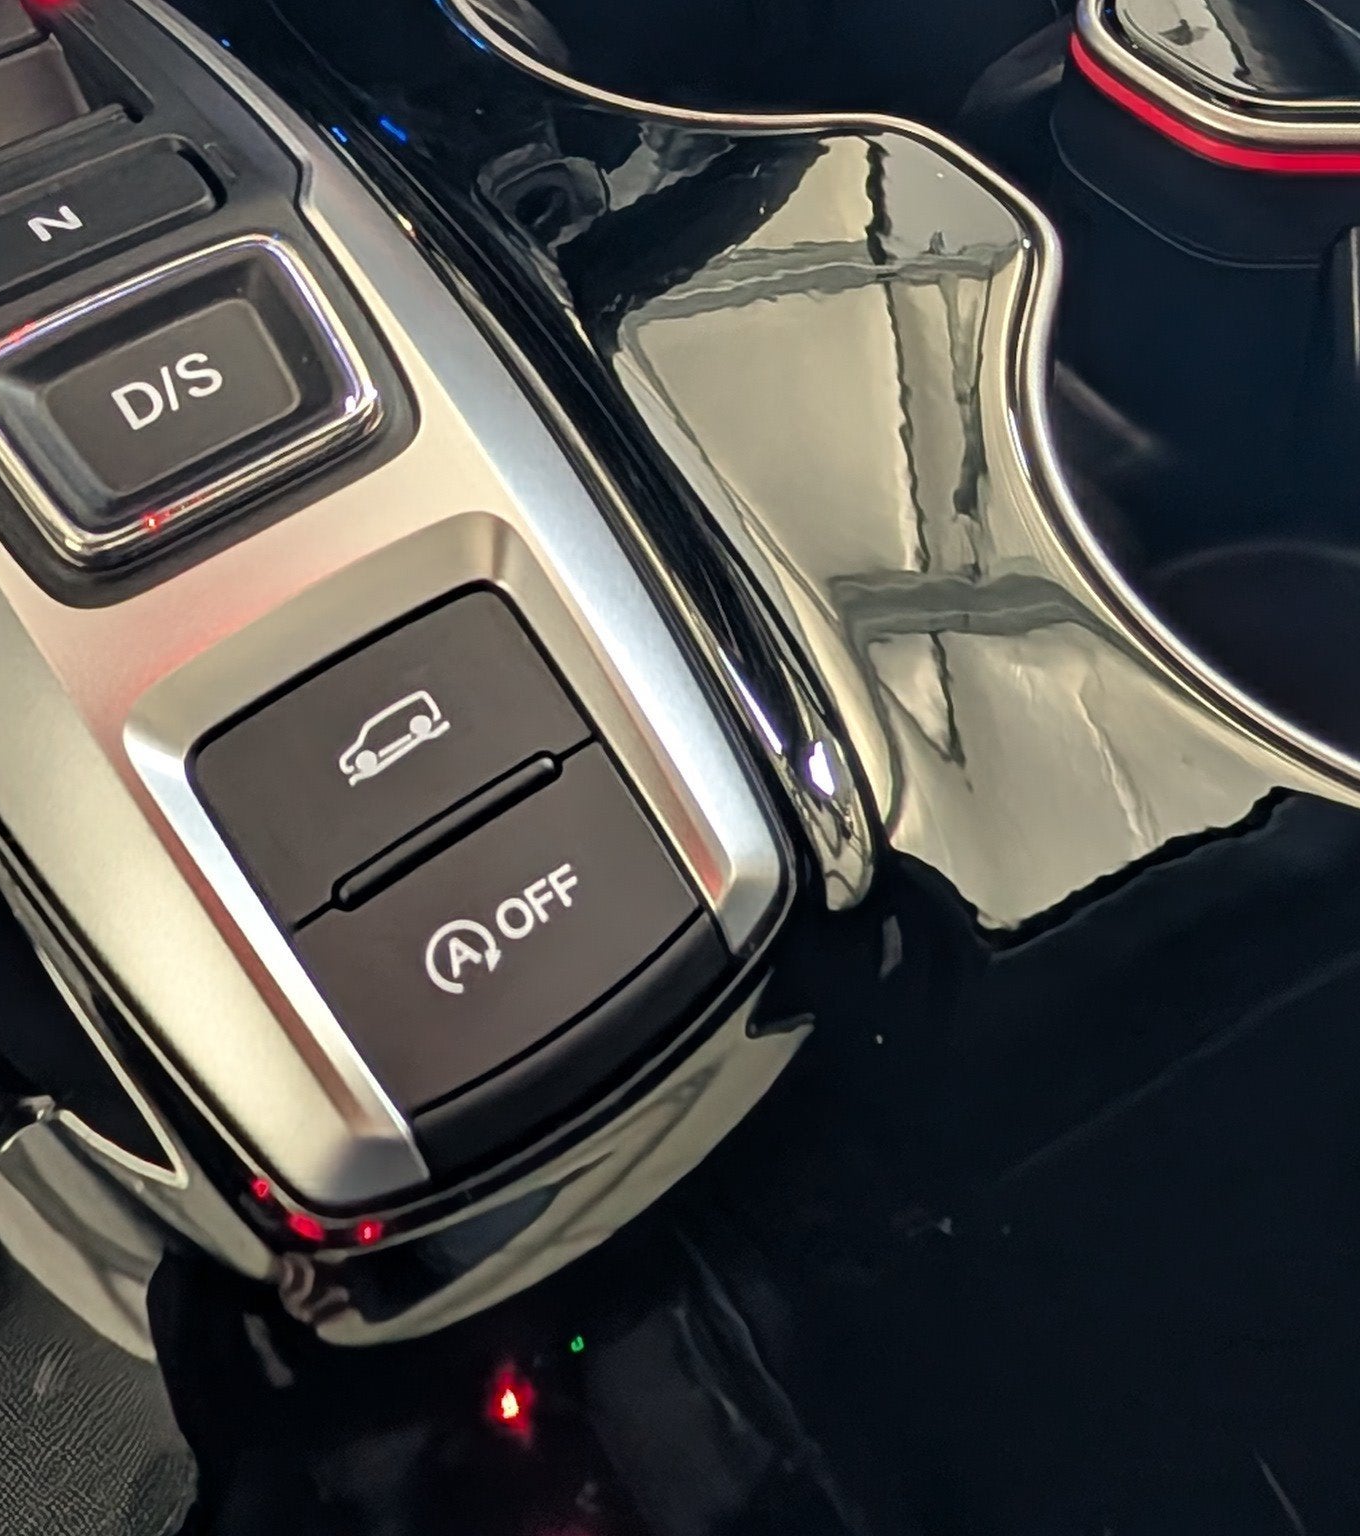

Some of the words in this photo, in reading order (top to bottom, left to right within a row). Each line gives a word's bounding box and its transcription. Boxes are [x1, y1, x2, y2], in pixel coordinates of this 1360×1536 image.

[27, 204, 84, 242] N
[110, 351, 224, 431] D/S
[495, 862, 579, 941] OFF
